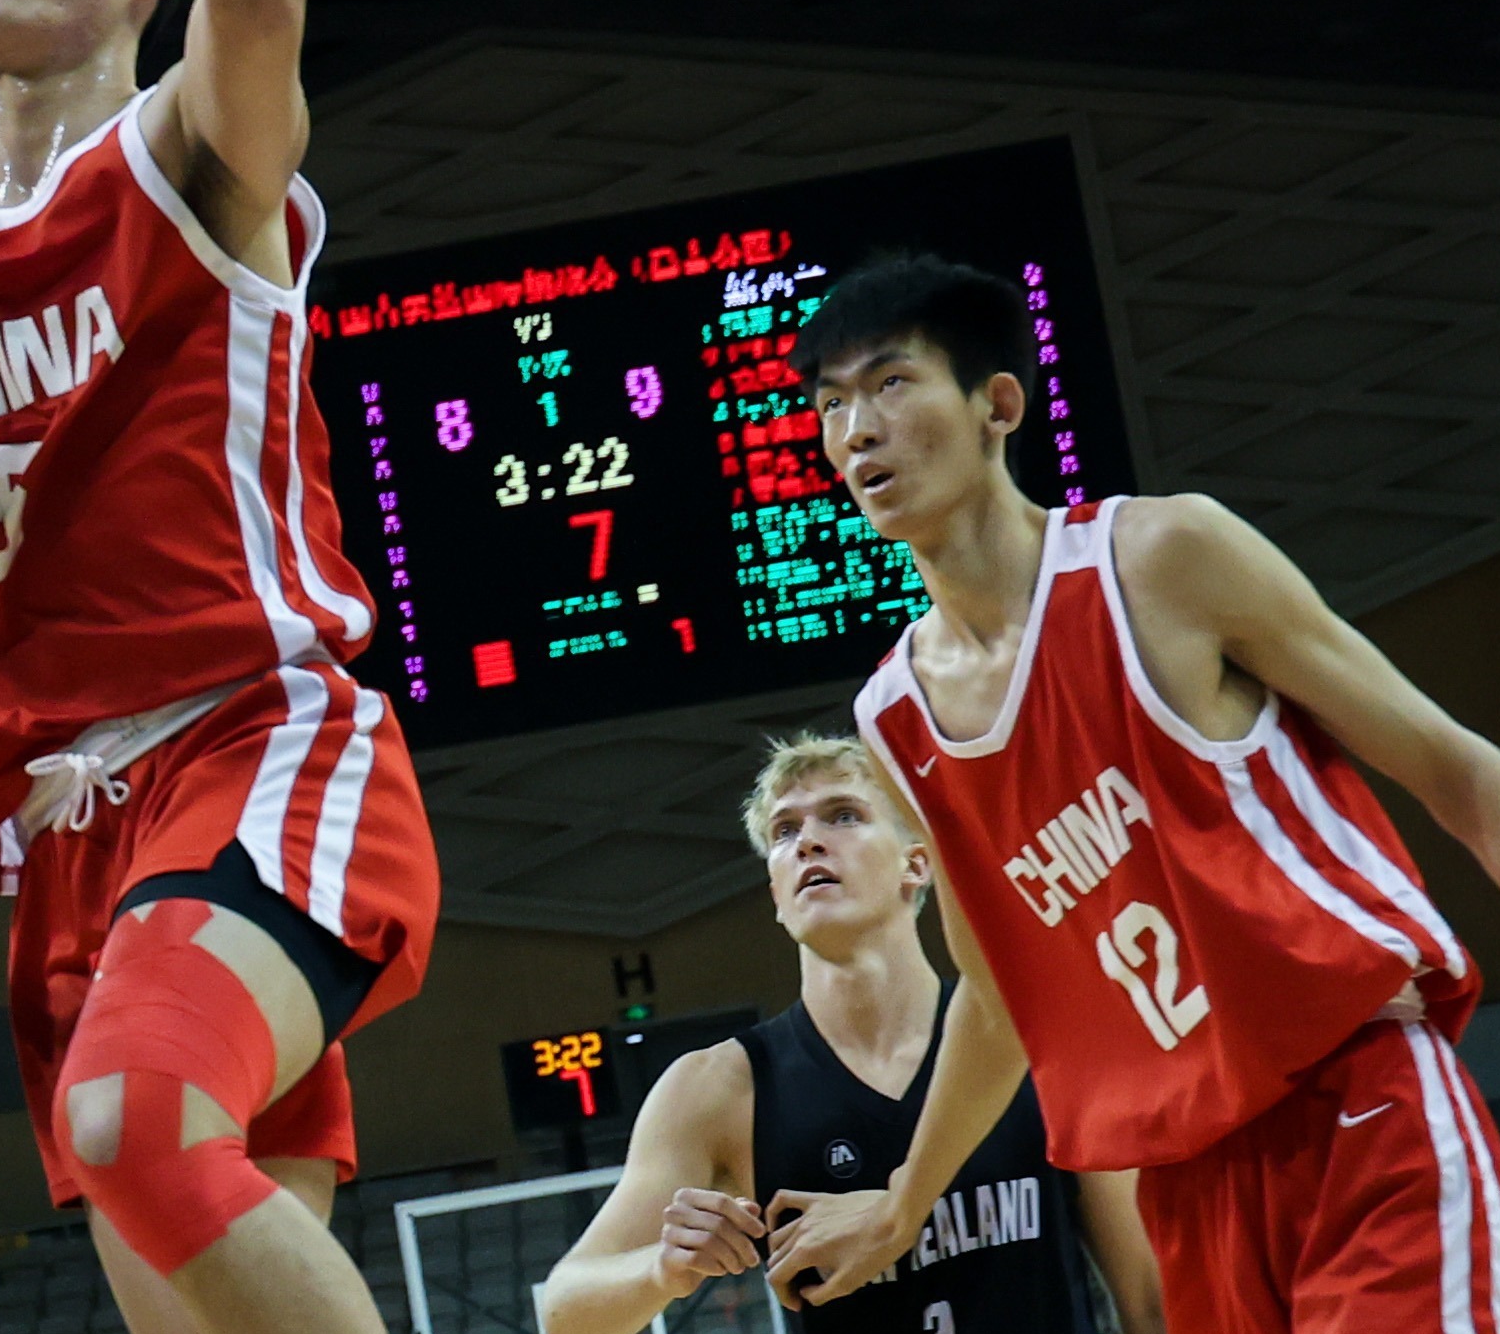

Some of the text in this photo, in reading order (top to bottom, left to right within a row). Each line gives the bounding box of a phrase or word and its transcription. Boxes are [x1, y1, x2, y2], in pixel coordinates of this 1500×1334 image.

[537, 391, 561, 428] 1
[625, 365, 661, 418] 9
[435, 398, 474, 452] 8
[494, 436, 635, 507] 3:22
[569, 509, 614, 582] 7
[671, 617, 696, 654] 1
[1003, 766, 1153, 928] CHINA
[1096, 901, 1211, 1052] 12
[532, 1031, 603, 1077] 3:22
[558, 1067, 597, 1116] 7
[911, 1177, 1041, 1271] EALAND
